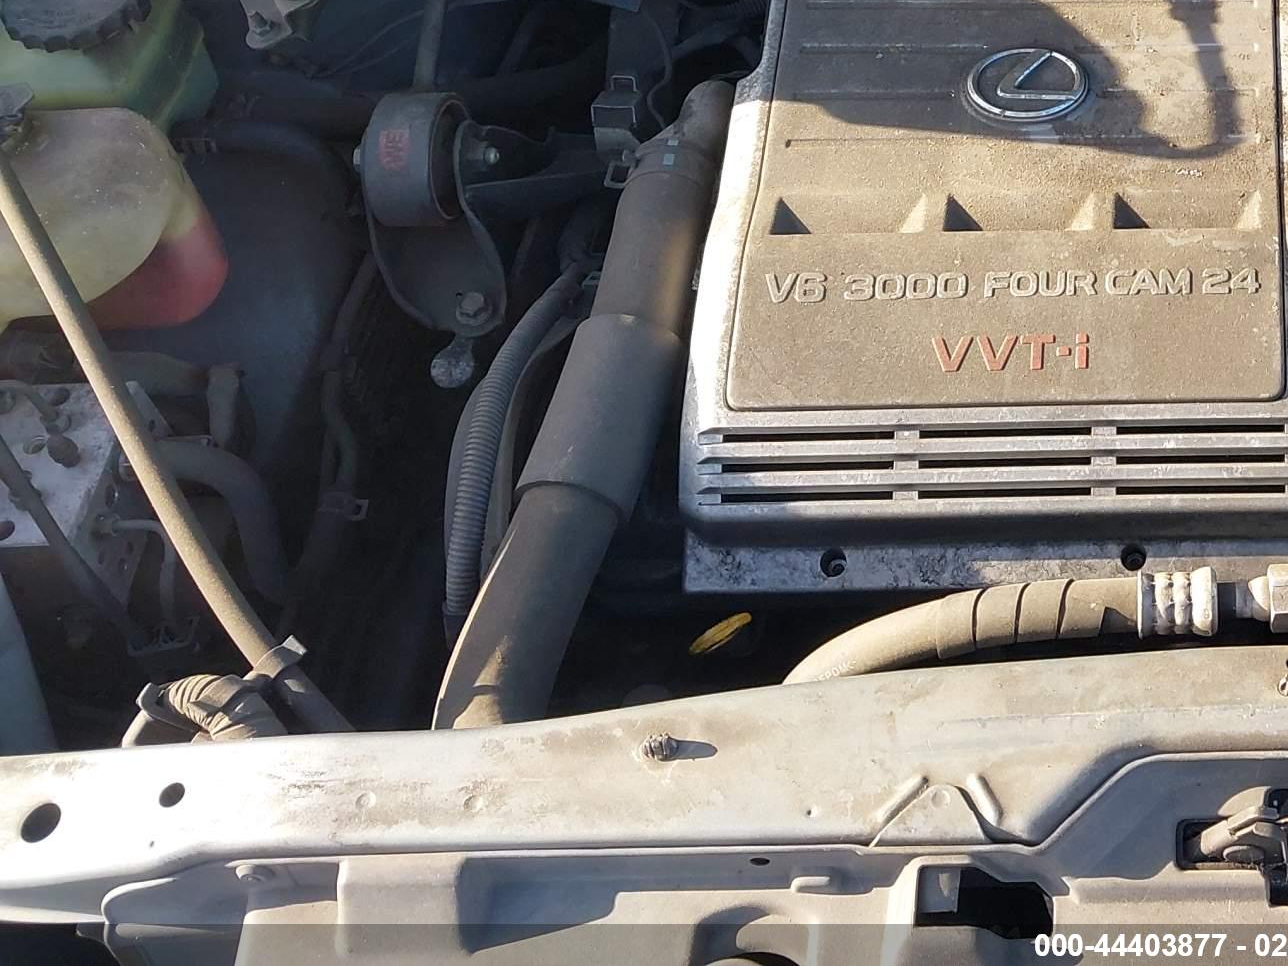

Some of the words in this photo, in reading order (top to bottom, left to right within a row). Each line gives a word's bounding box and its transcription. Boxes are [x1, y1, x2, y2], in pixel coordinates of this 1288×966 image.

[765, 272, 828, 304] V6
[844, 271, 969, 301] 3000
[983, 269, 1100, 299] FOUR
[1105, 268, 1194, 298] CAM
[1201, 267, 1262, 295] 24
[931, 332, 1091, 373] VVT-i
